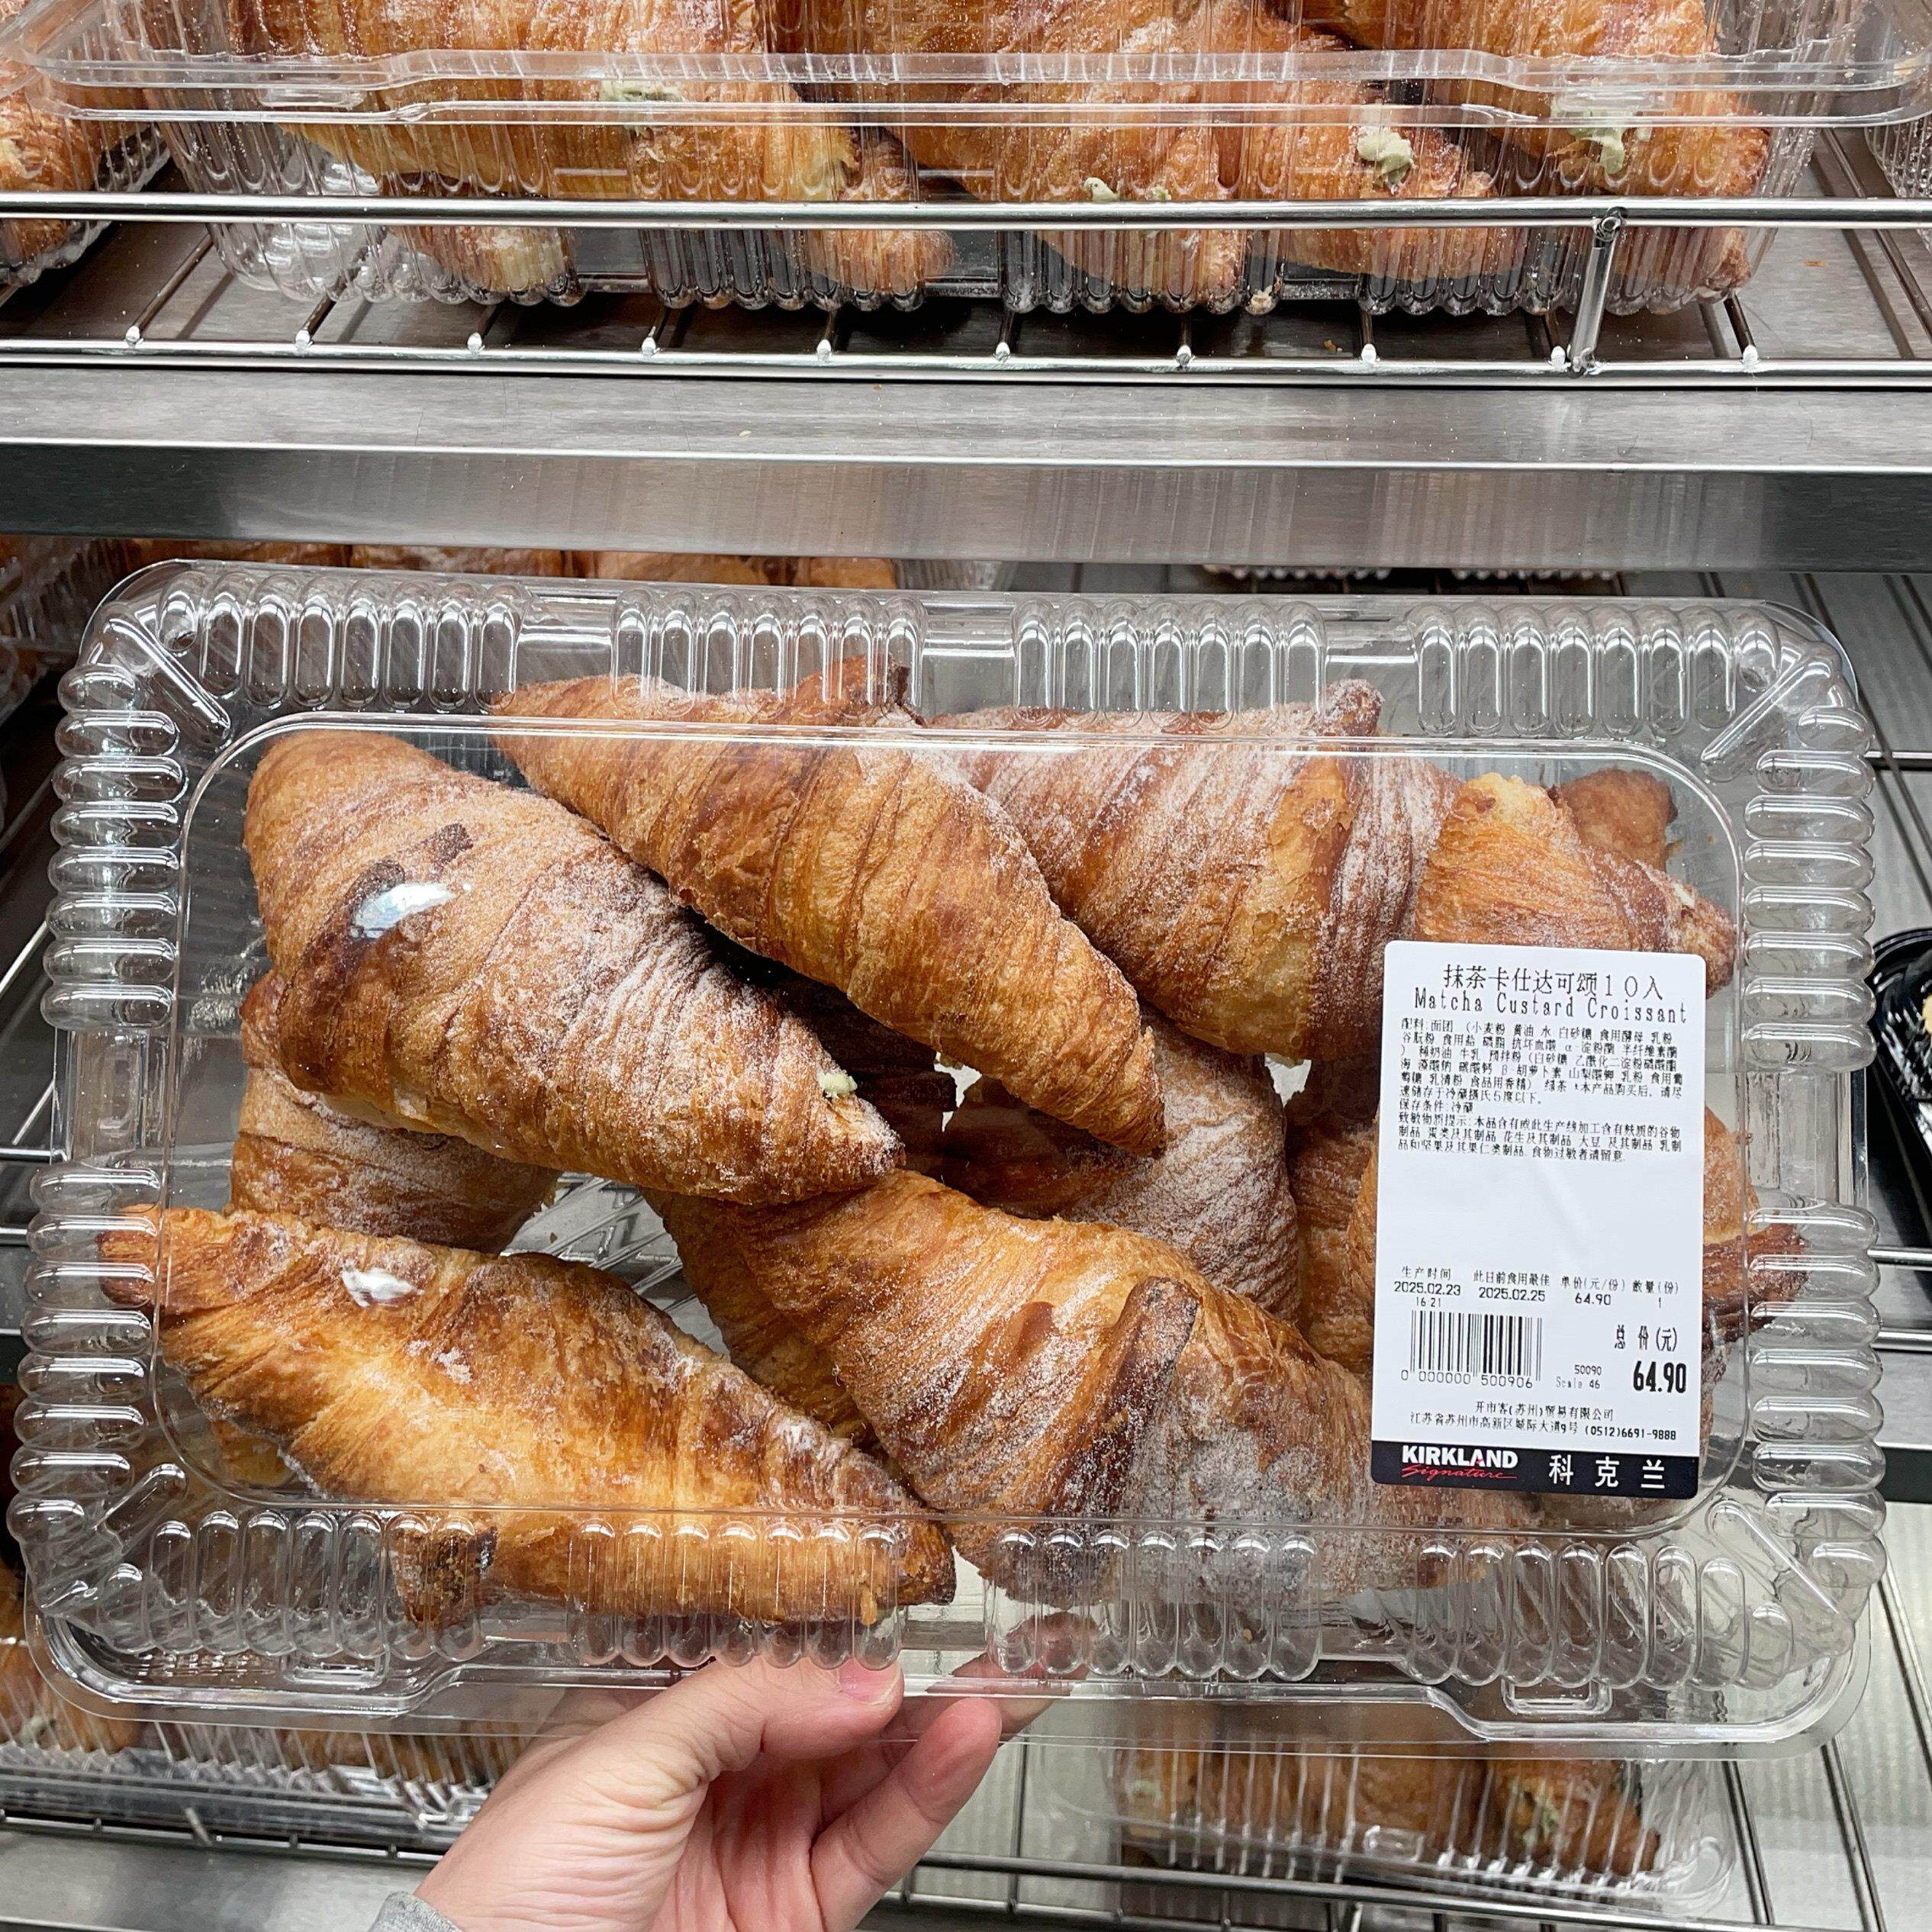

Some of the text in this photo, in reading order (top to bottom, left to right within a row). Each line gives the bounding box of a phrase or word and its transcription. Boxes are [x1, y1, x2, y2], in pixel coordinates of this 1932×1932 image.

[1443, 963, 1663, 1000] 抹茶卡仕达可颂10入
[1414, 987, 1686, 1023] Matcha Custard Croissant
[1393, 1280, 1460, 1296] 2025.02.23
[1478, 1287, 1546, 1301] 2025.02.25
[1575, 1293, 1611, 1305] 64.90
[1481, 1374, 1533, 1388] 500906
[1574, 1364, 1602, 1375] 50090
[1633, 1360, 1686, 1393] 64.90
[1589, 1379, 1600, 1389] 46
[1585, 1425, 1676, 1440] (0512)6691-9888
[1401, 1462, 1517, 1486] Signature
[1402, 1444, 1666, 1489] KIRKLAND 科克兰
